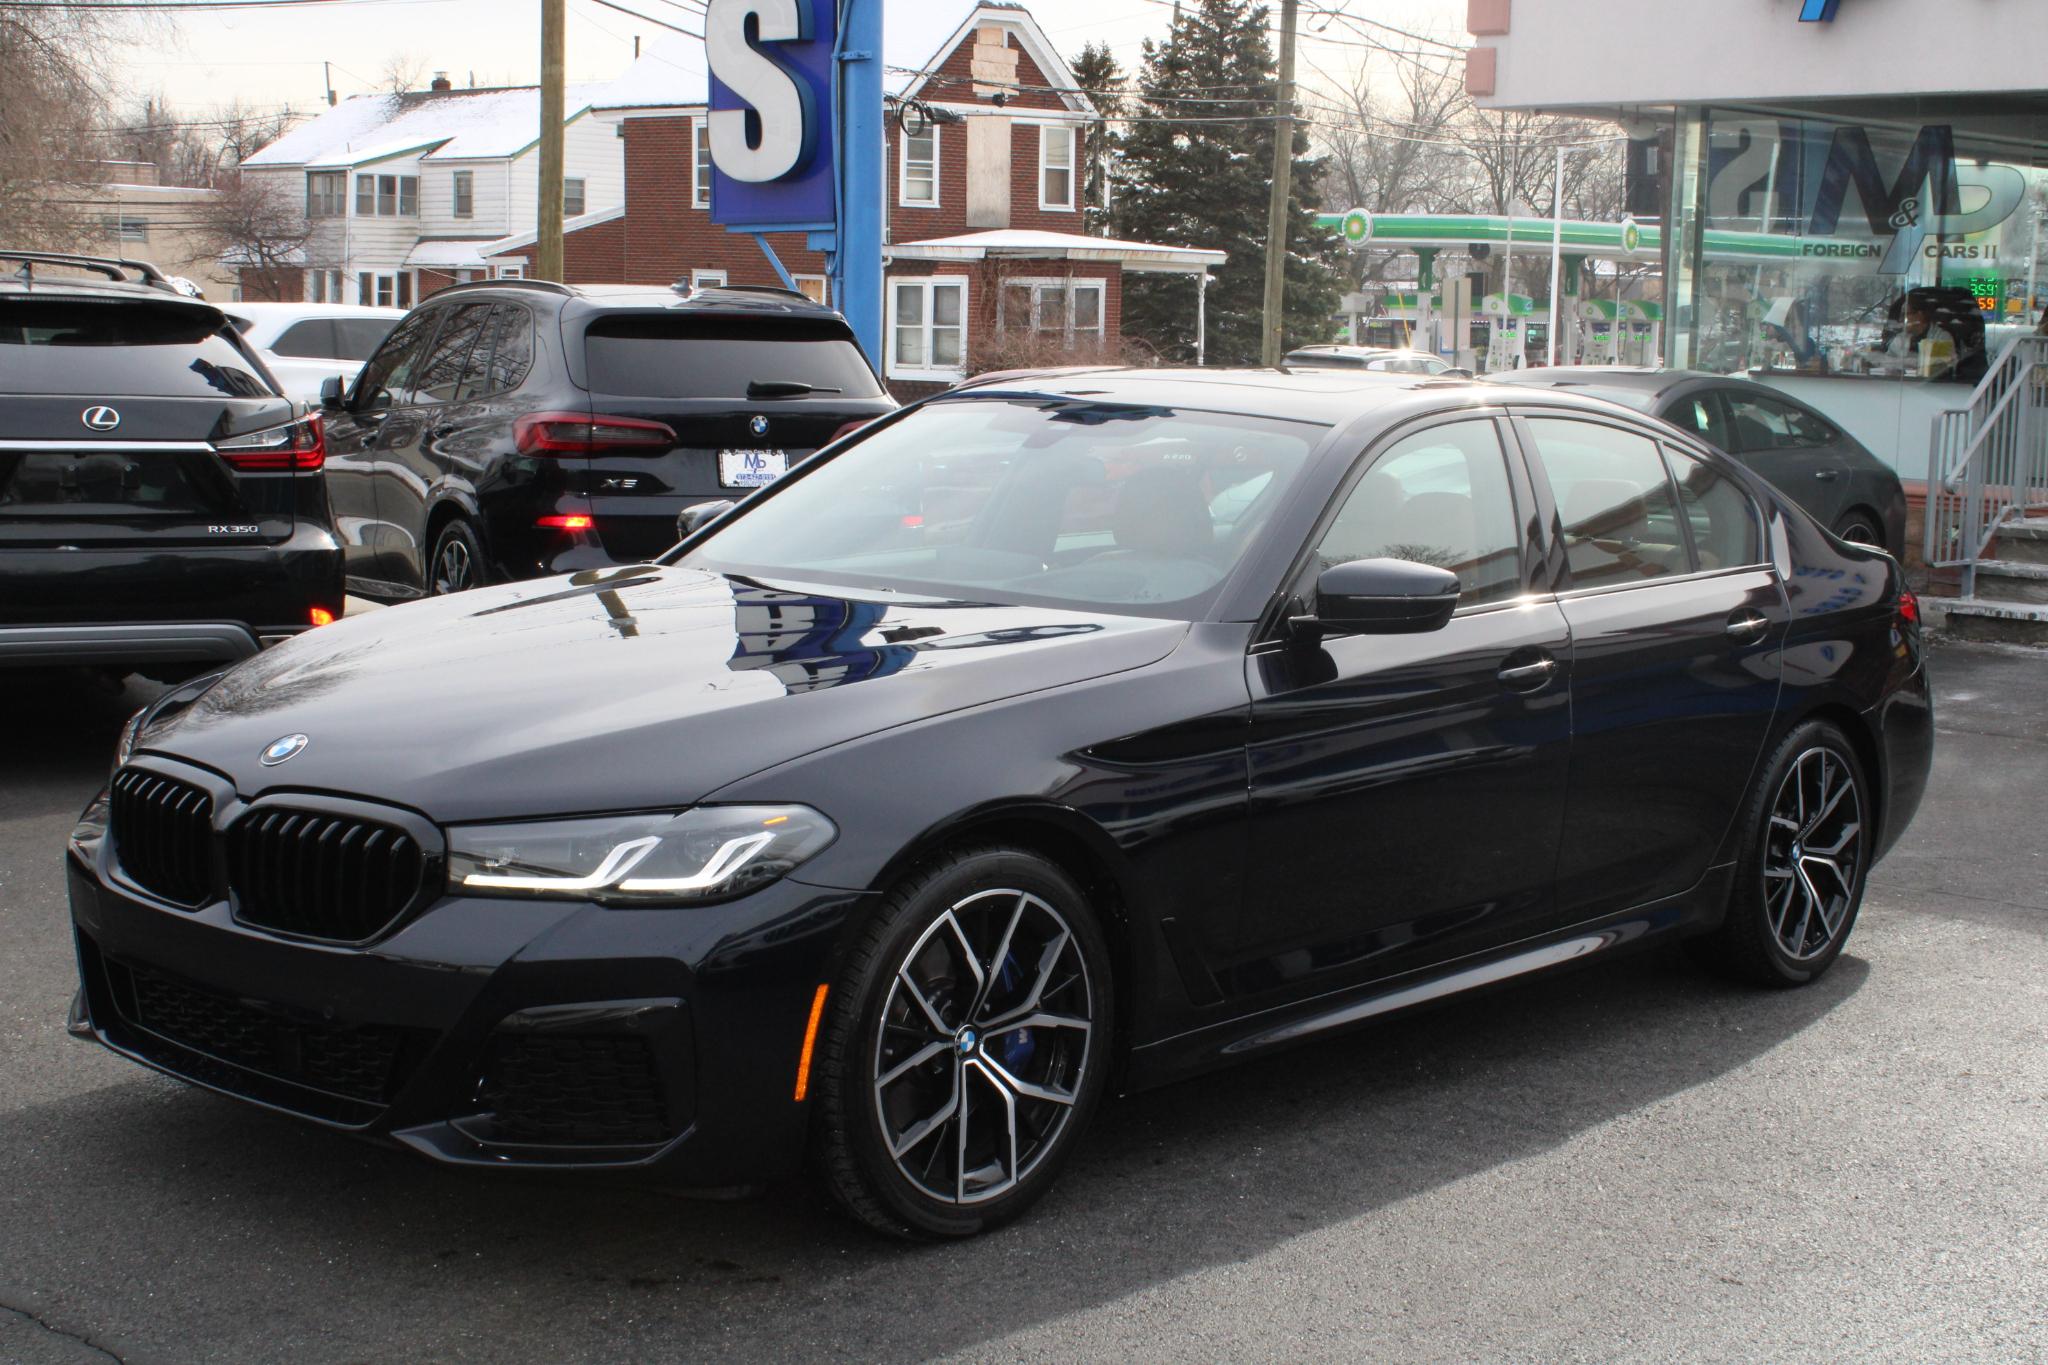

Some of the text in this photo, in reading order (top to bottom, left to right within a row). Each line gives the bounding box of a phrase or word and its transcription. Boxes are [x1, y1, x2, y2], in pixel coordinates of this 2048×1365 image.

[705, 0, 803, 183] S
[1802, 243, 1998, 259] FOREIGN CARS II
